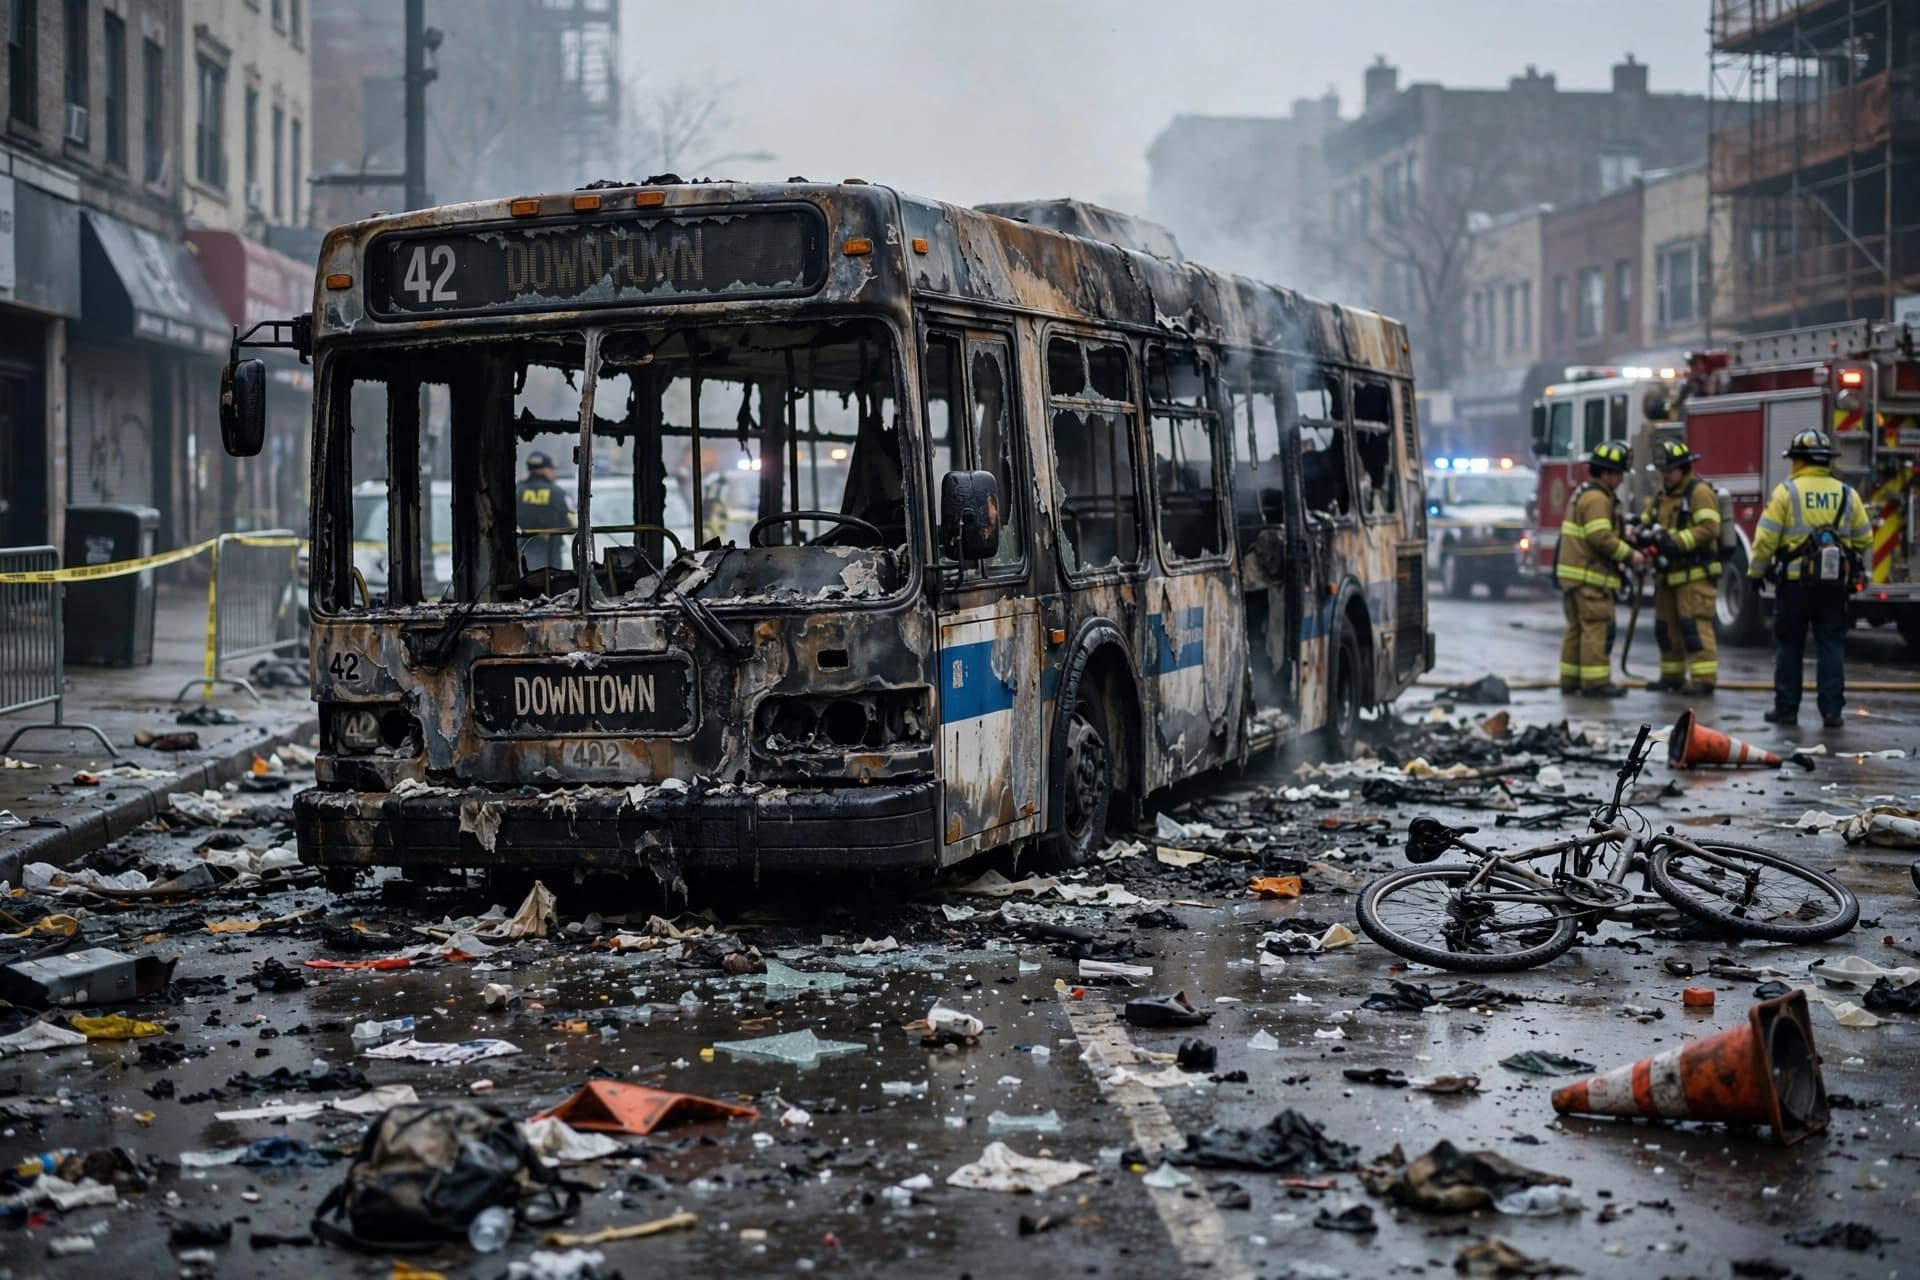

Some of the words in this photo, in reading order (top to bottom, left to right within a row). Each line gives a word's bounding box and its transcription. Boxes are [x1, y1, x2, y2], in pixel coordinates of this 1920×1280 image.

[403, 244, 457, 303] 42
[506, 227, 703, 292] DOWNTOWN
[1805, 492, 1839, 510] EMT
[329, 652, 360, 680] 42
[514, 674, 656, 716] DOWNTOWN
